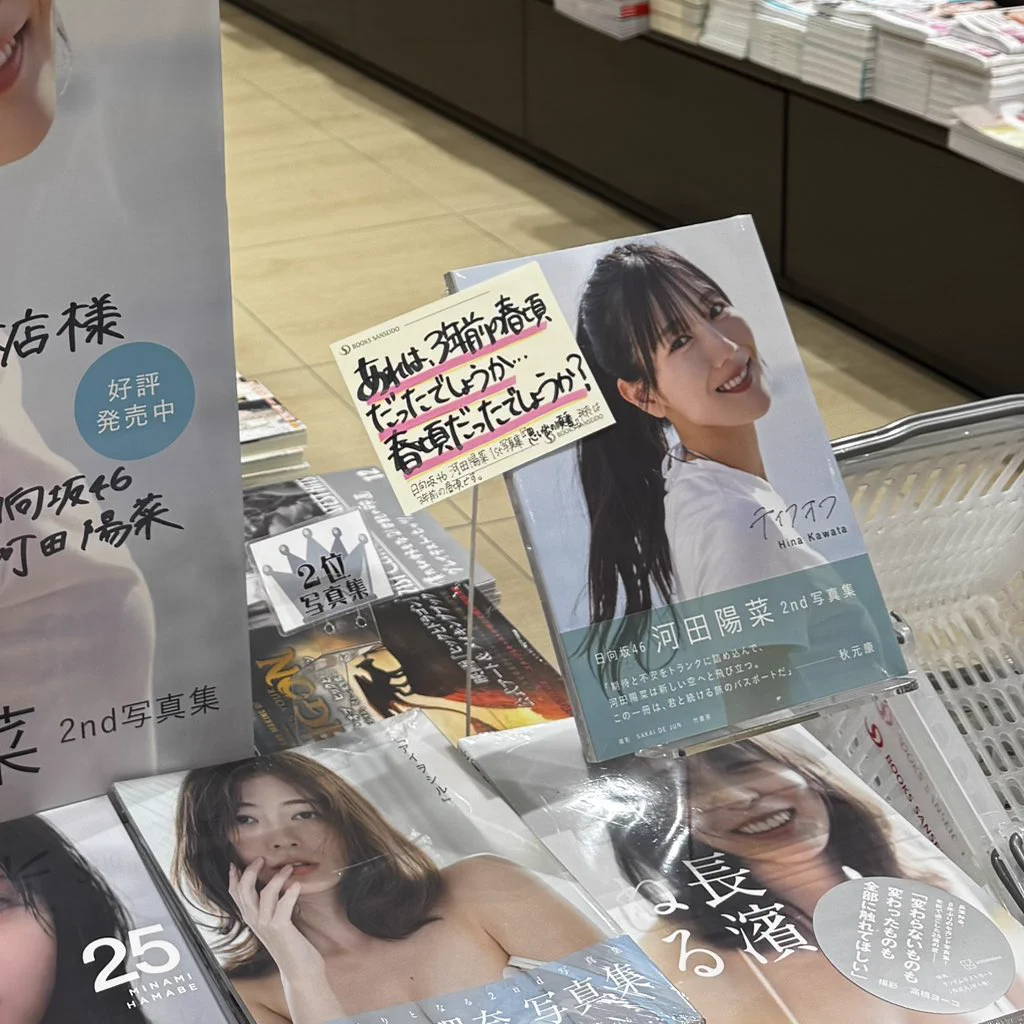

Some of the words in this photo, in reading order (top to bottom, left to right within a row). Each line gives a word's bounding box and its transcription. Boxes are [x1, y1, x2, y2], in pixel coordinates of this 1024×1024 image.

[352, 335, 373, 350] BOOKS
[373, 326, 400, 342] SANSEIDO
[107, 373, 161, 402] 好評
[98, 399, 176, 433] 発売中
[778, 537, 804, 550] Hina
[807, 525, 848, 542] Kawata
[297, 552, 352, 589] 2位
[300, 577, 370, 618] 写真集
[594, 642, 647, 666] 日向坂46
[651, 597, 775, 655] 河田陽菜
[839, 641, 876, 662] 秋元康
[59, 684, 221, 743] 2nd写真集
[885, 754, 914, 803] BOOKS
[682, 851, 818, 964] 長濱
[82, 924, 181, 993] 25
[126, 983, 198, 1010] HAMABE
[129, 973, 193, 996] MINAMI
